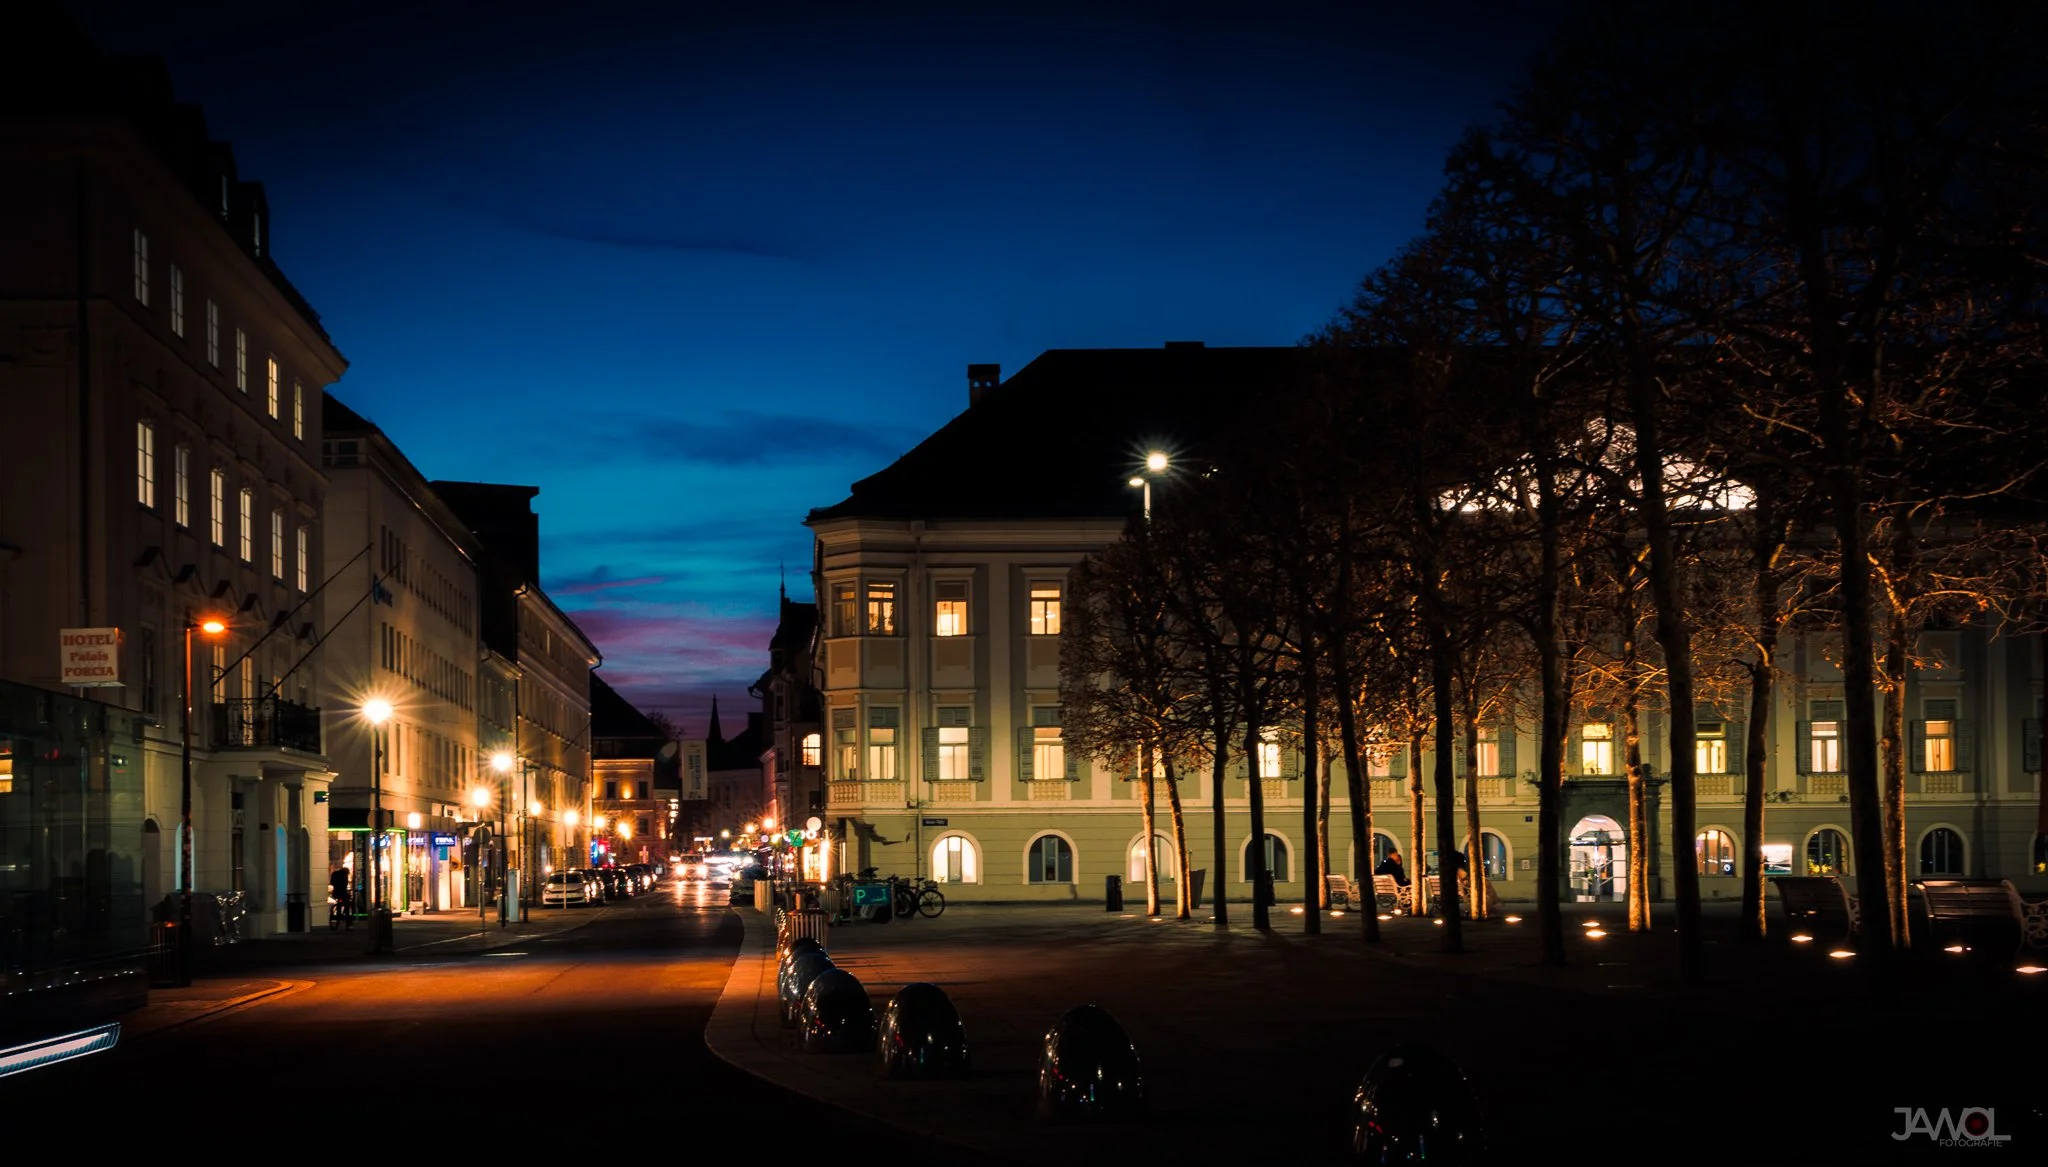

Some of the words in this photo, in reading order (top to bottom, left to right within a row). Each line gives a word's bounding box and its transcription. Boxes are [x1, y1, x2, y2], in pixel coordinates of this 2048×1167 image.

[63, 634, 114, 646] HOTEL
[70, 651, 109, 662] Palais
[64, 667, 115, 677] PORCIA
[856, 889, 867, 904] P
